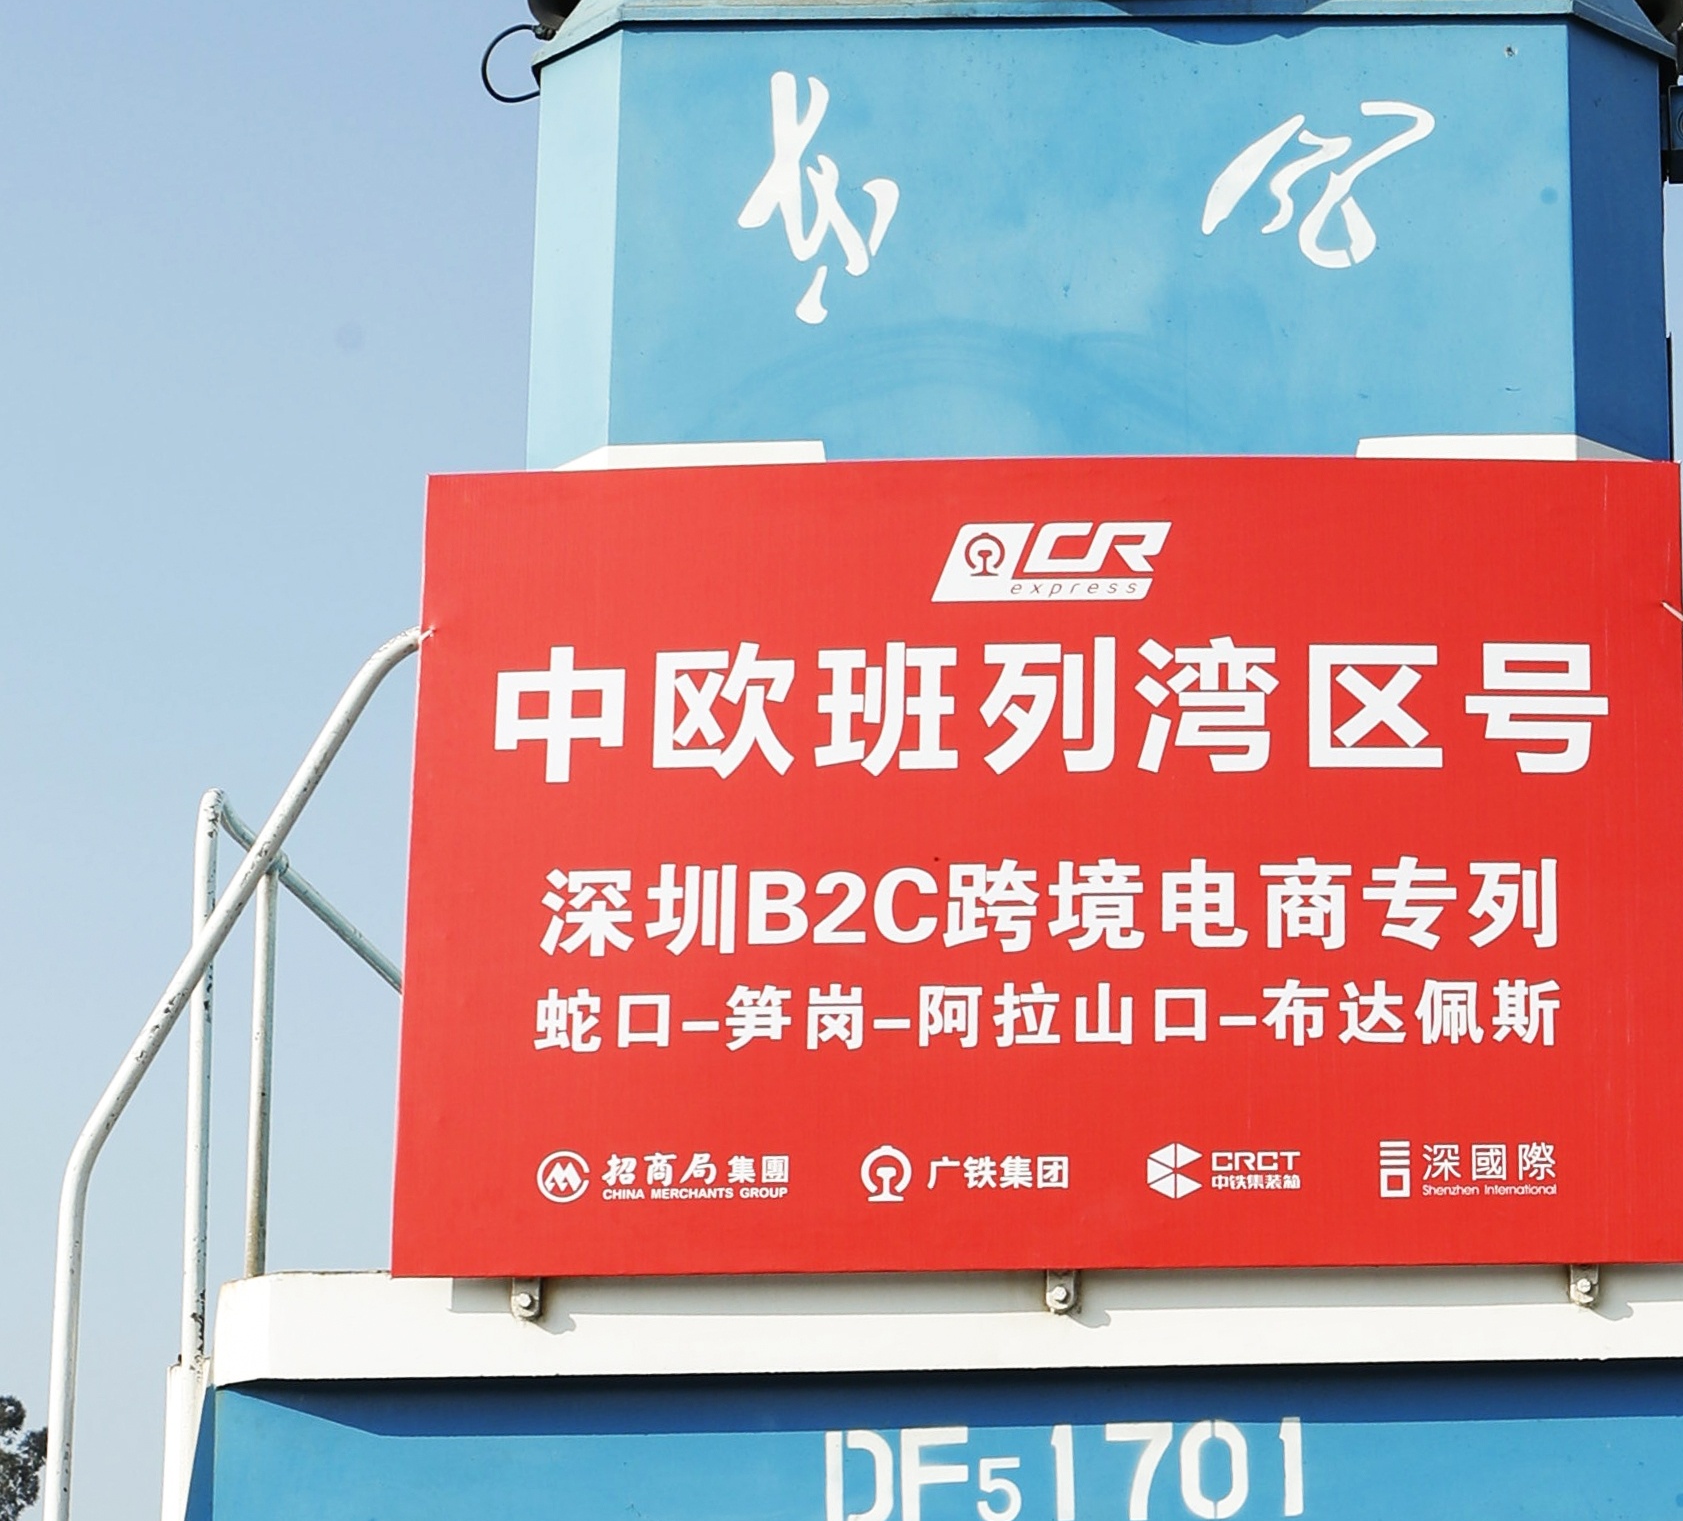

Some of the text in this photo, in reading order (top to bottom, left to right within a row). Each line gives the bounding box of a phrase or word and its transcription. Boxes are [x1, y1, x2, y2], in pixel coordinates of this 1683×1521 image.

[1023, 521, 1173, 573] CR
[1010, 580, 1139, 598] express
[493, 636, 1609, 783] 中欧班列湾区号
[540, 856, 1561, 958] 深圳B2C跨境电商专列
[927, 1155, 1069, 1189] 广铁集团
[1211, 1151, 1301, 1171] CRCT
[1422, 1142, 1556, 1181] 深國際
[602, 1186, 788, 1201] CHINA MERCHANTS GROUP
[1211, 1174, 1301, 1190] 中铁集装箱
[1422, 1183, 1557, 1196] Shenzhen International
